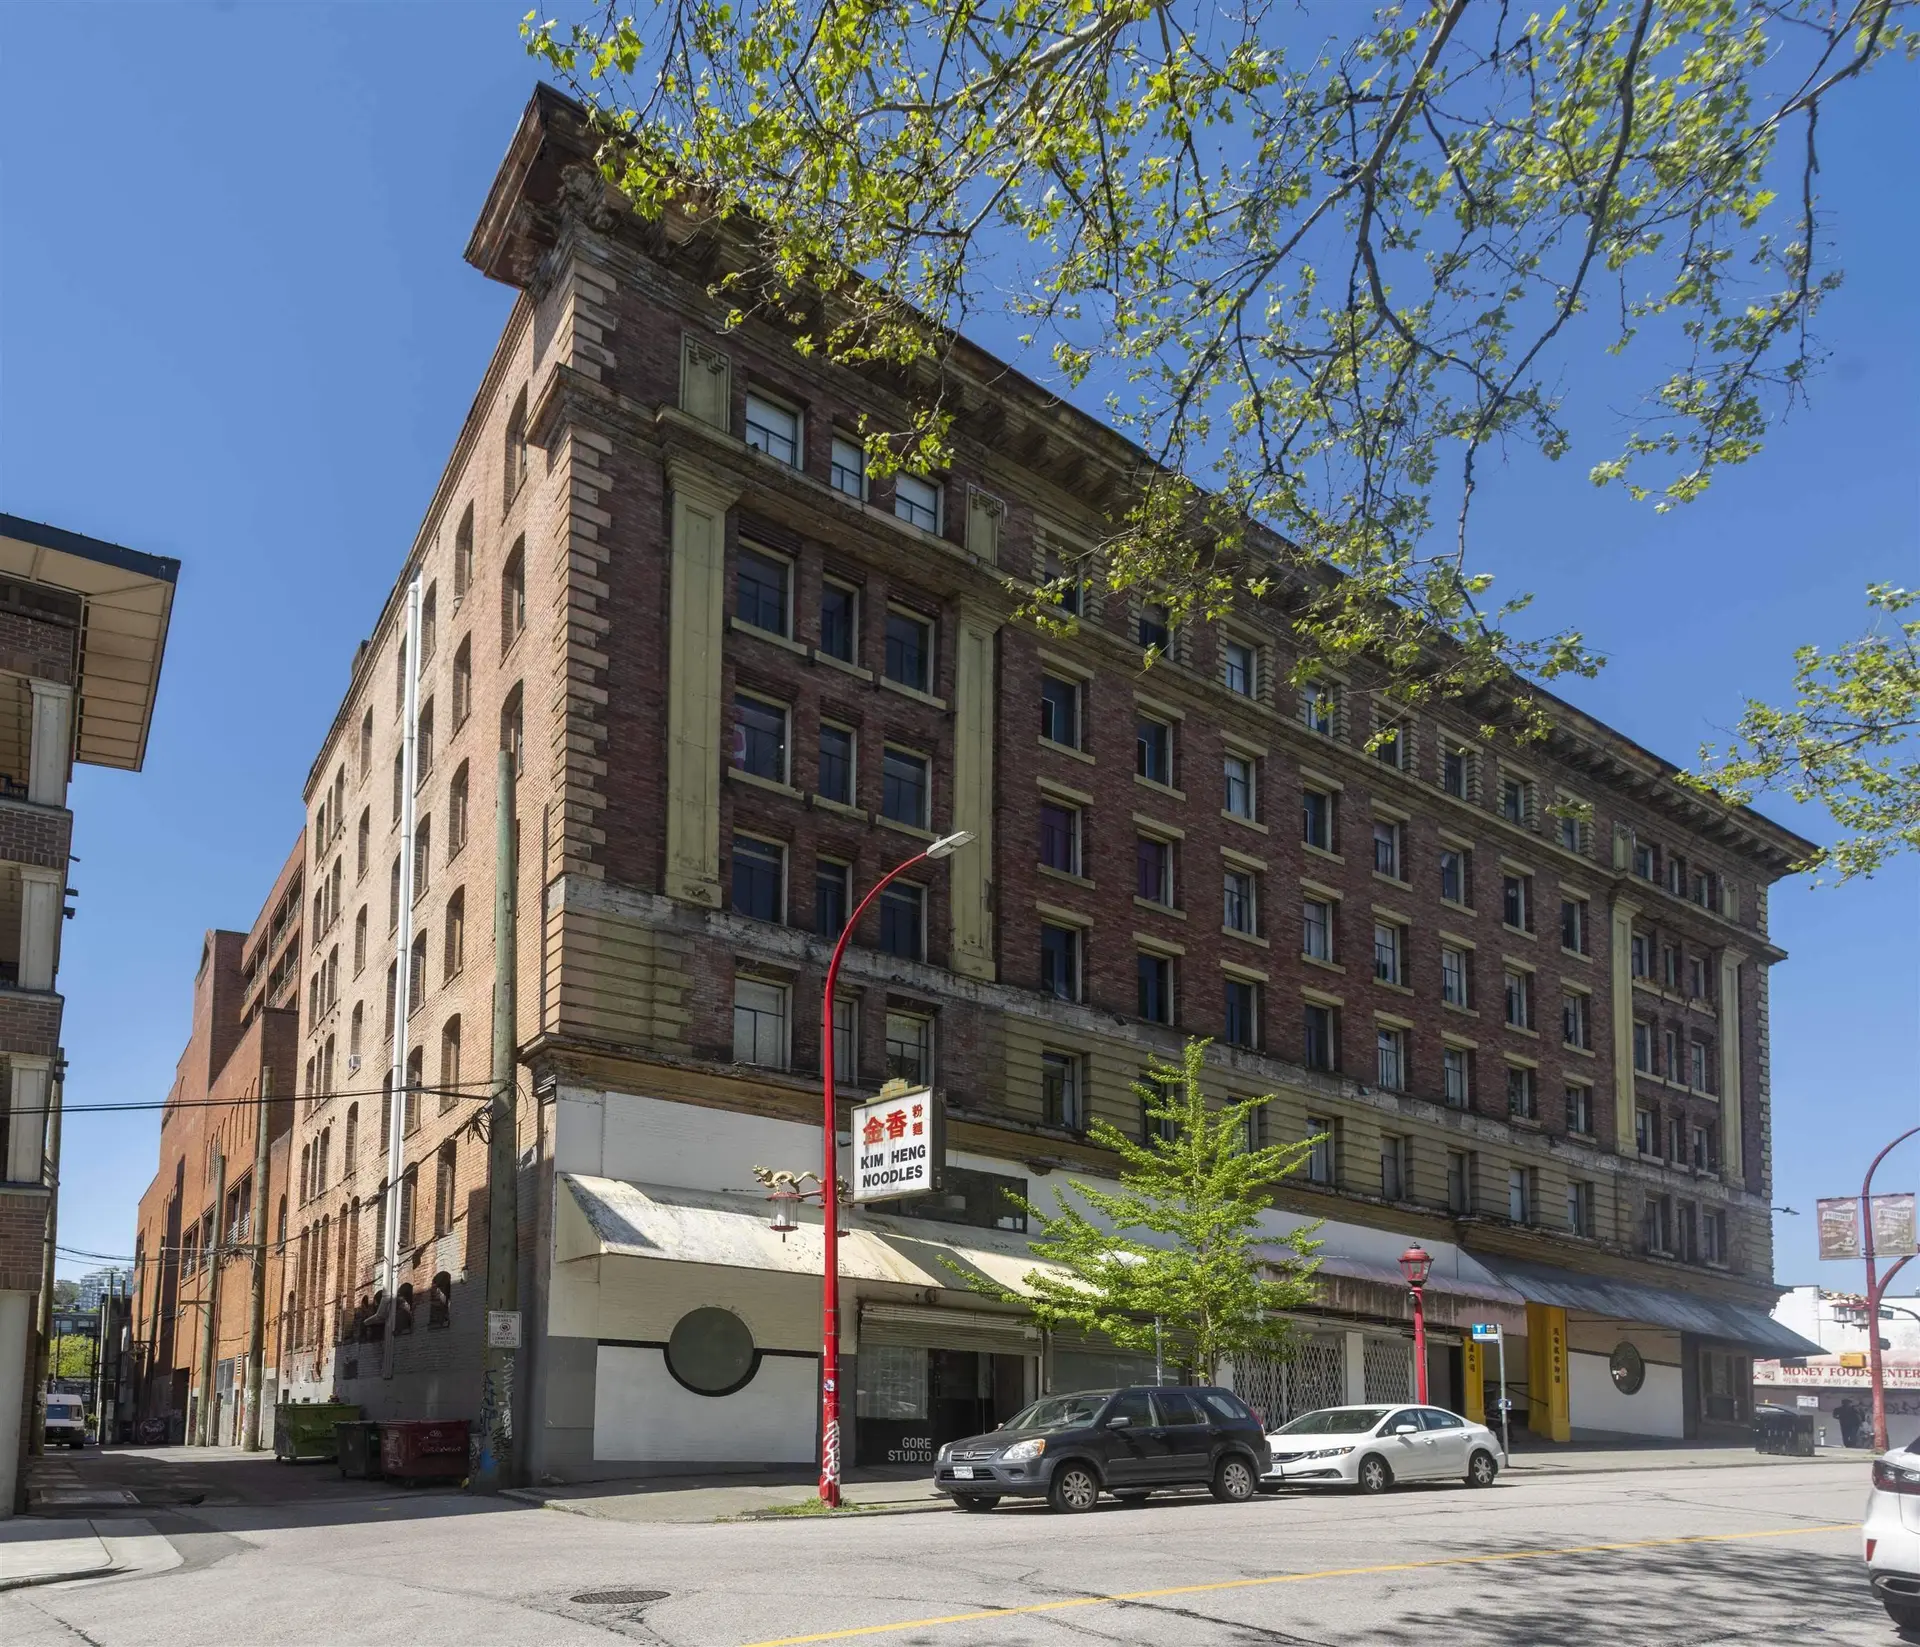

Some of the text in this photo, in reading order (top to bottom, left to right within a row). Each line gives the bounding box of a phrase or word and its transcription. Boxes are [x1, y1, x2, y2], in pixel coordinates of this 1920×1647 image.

[863, 1109, 908, 1145] 金香
[861, 1144, 926, 1170] KIM HENG
[862, 1164, 923, 1188] NOODLES
[1782, 1367, 1824, 1376] MONEY
[1829, 1367, 1874, 1377] FOODS
[902, 1437, 932, 1449] GORE
[888, 1449, 932, 1462] STUDIO
